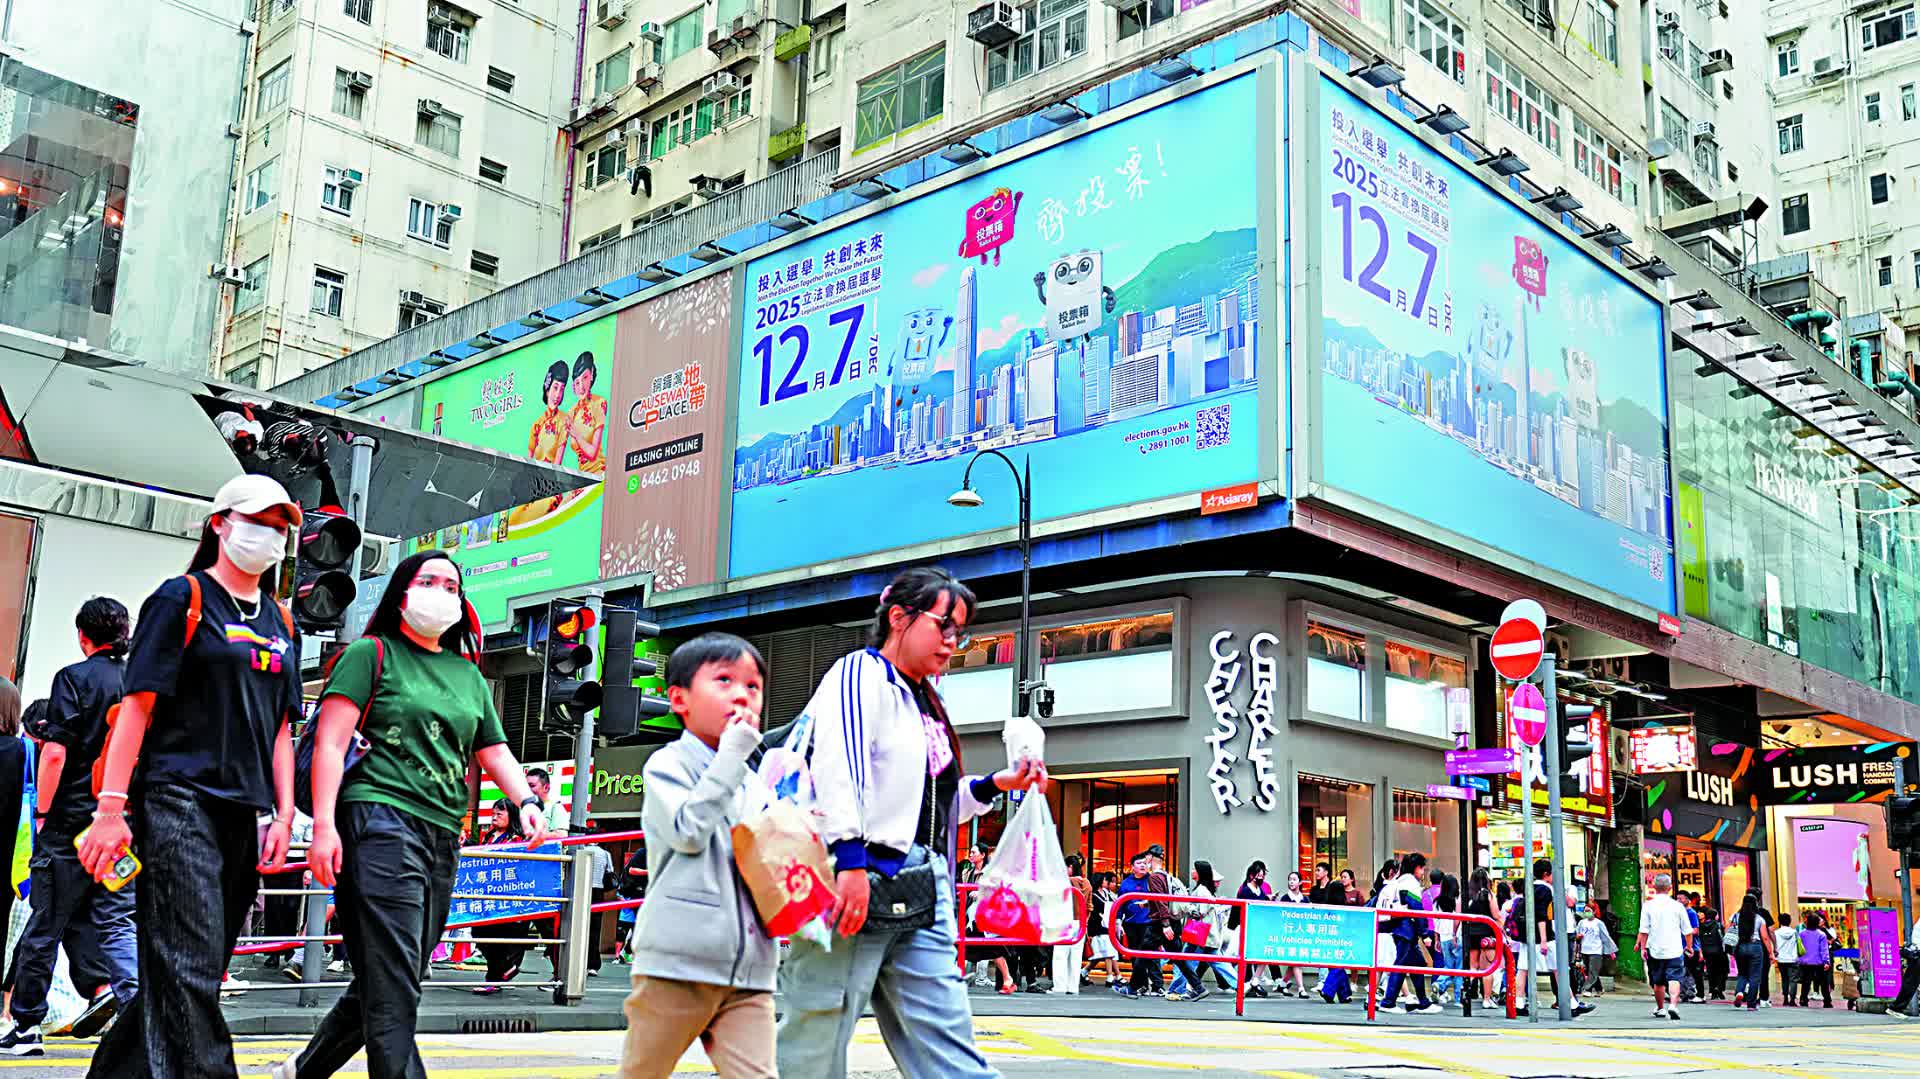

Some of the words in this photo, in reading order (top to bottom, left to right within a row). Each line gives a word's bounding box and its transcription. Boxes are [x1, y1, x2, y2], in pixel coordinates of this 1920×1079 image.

[1332, 108, 1387, 159] 投入選舉
[1398, 152, 1449, 199] 共創未來
[976, 220, 1004, 242] 投票箱
[758, 258, 813, 293] 投入選舉
[824, 233, 883, 270] 共創未來
[777, 283, 800, 295] Election
[800, 274, 824, 288] Together
[834, 263, 853, 275] Create
[863, 253, 883, 264] Future
[1059, 305, 1089, 325] 投票箱
[1444, 304, 1452, 336] DEC
[868, 346, 878, 375] DEC
[645, 400, 688, 431] PLACE
[1124, 420, 1190, 443] elections.gov.hk
[1149, 439, 1169, 452] 2891
[1170, 435, 1190, 447] 1001
[630, 448, 663, 467] LEASING
[665, 438, 699, 457] HOTLINE
[642, 467, 669, 489] 6462
[671, 459, 700, 480] 0948
[1217, 492, 1254, 506] Asiaray
[1204, 630, 1243, 815] CHESTER
[1247, 632, 1281, 812] CHARLES
[595, 769, 648, 796] Price
[1687, 768, 1734, 807] LUSH
[1773, 762, 1858, 789] LUSH
[1862, 761, 1895, 773] FRES
[1862, 771, 1896, 779] HANDMA
[487, 879, 536, 894] Prohibited
[1281, 910, 1321, 921] Pedestrian
[1323, 912, 1341, 922] Area
[1284, 922, 1339, 936] 行人專用區
[1268, 935, 1279, 943] All
[1281, 936, 1313, 945] Vehicles
[1315, 937, 1353, 947] Prohibited
